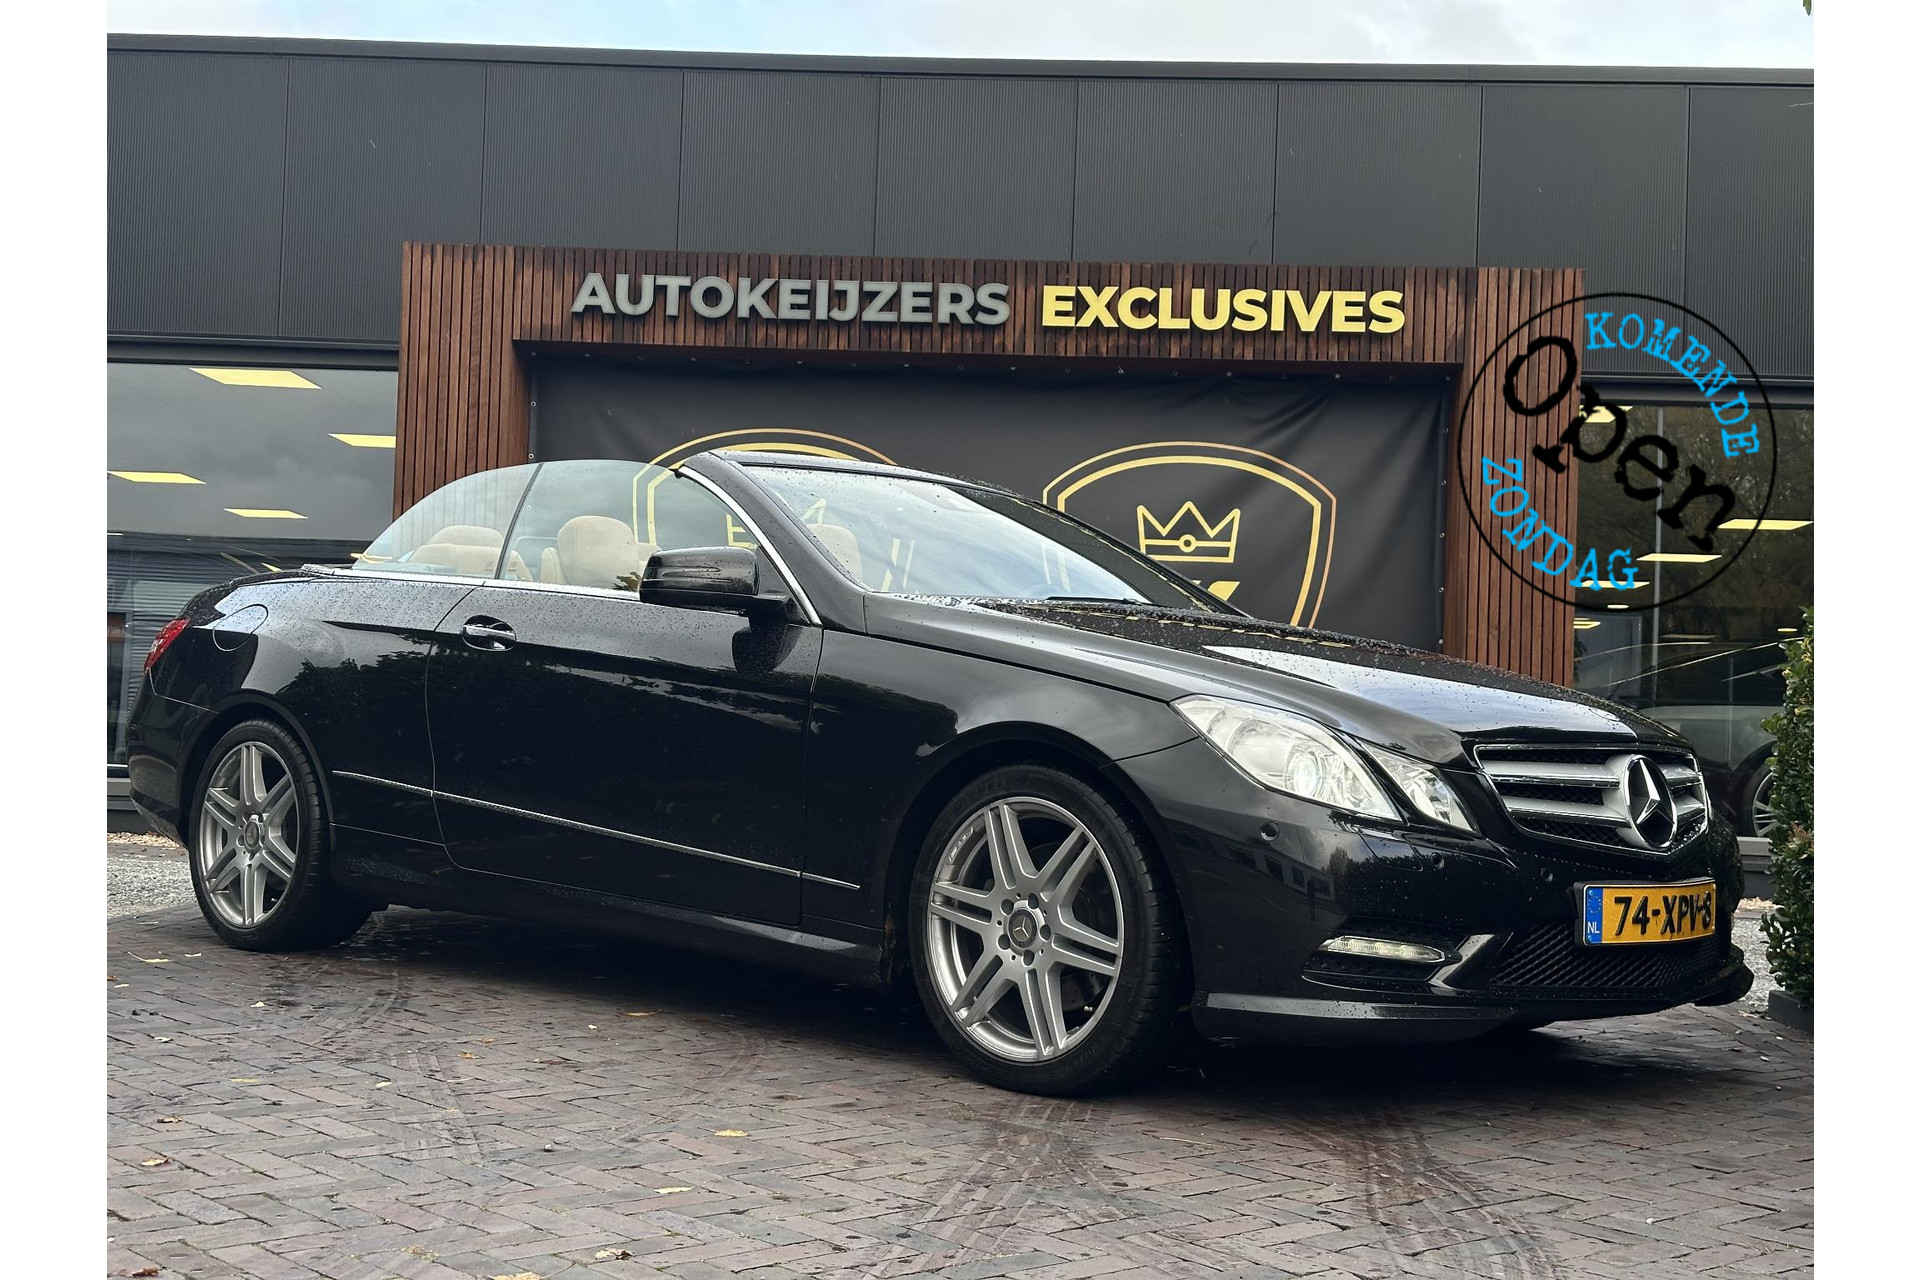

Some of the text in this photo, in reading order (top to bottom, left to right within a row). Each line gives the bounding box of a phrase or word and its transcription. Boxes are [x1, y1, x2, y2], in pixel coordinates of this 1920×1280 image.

[570, 272, 1405, 334] AUTOKEIJZERS EXCLUSIVES
[1587, 921, 1600, 934] NL
[1612, 890, 1712, 936] 74-XPV-8
